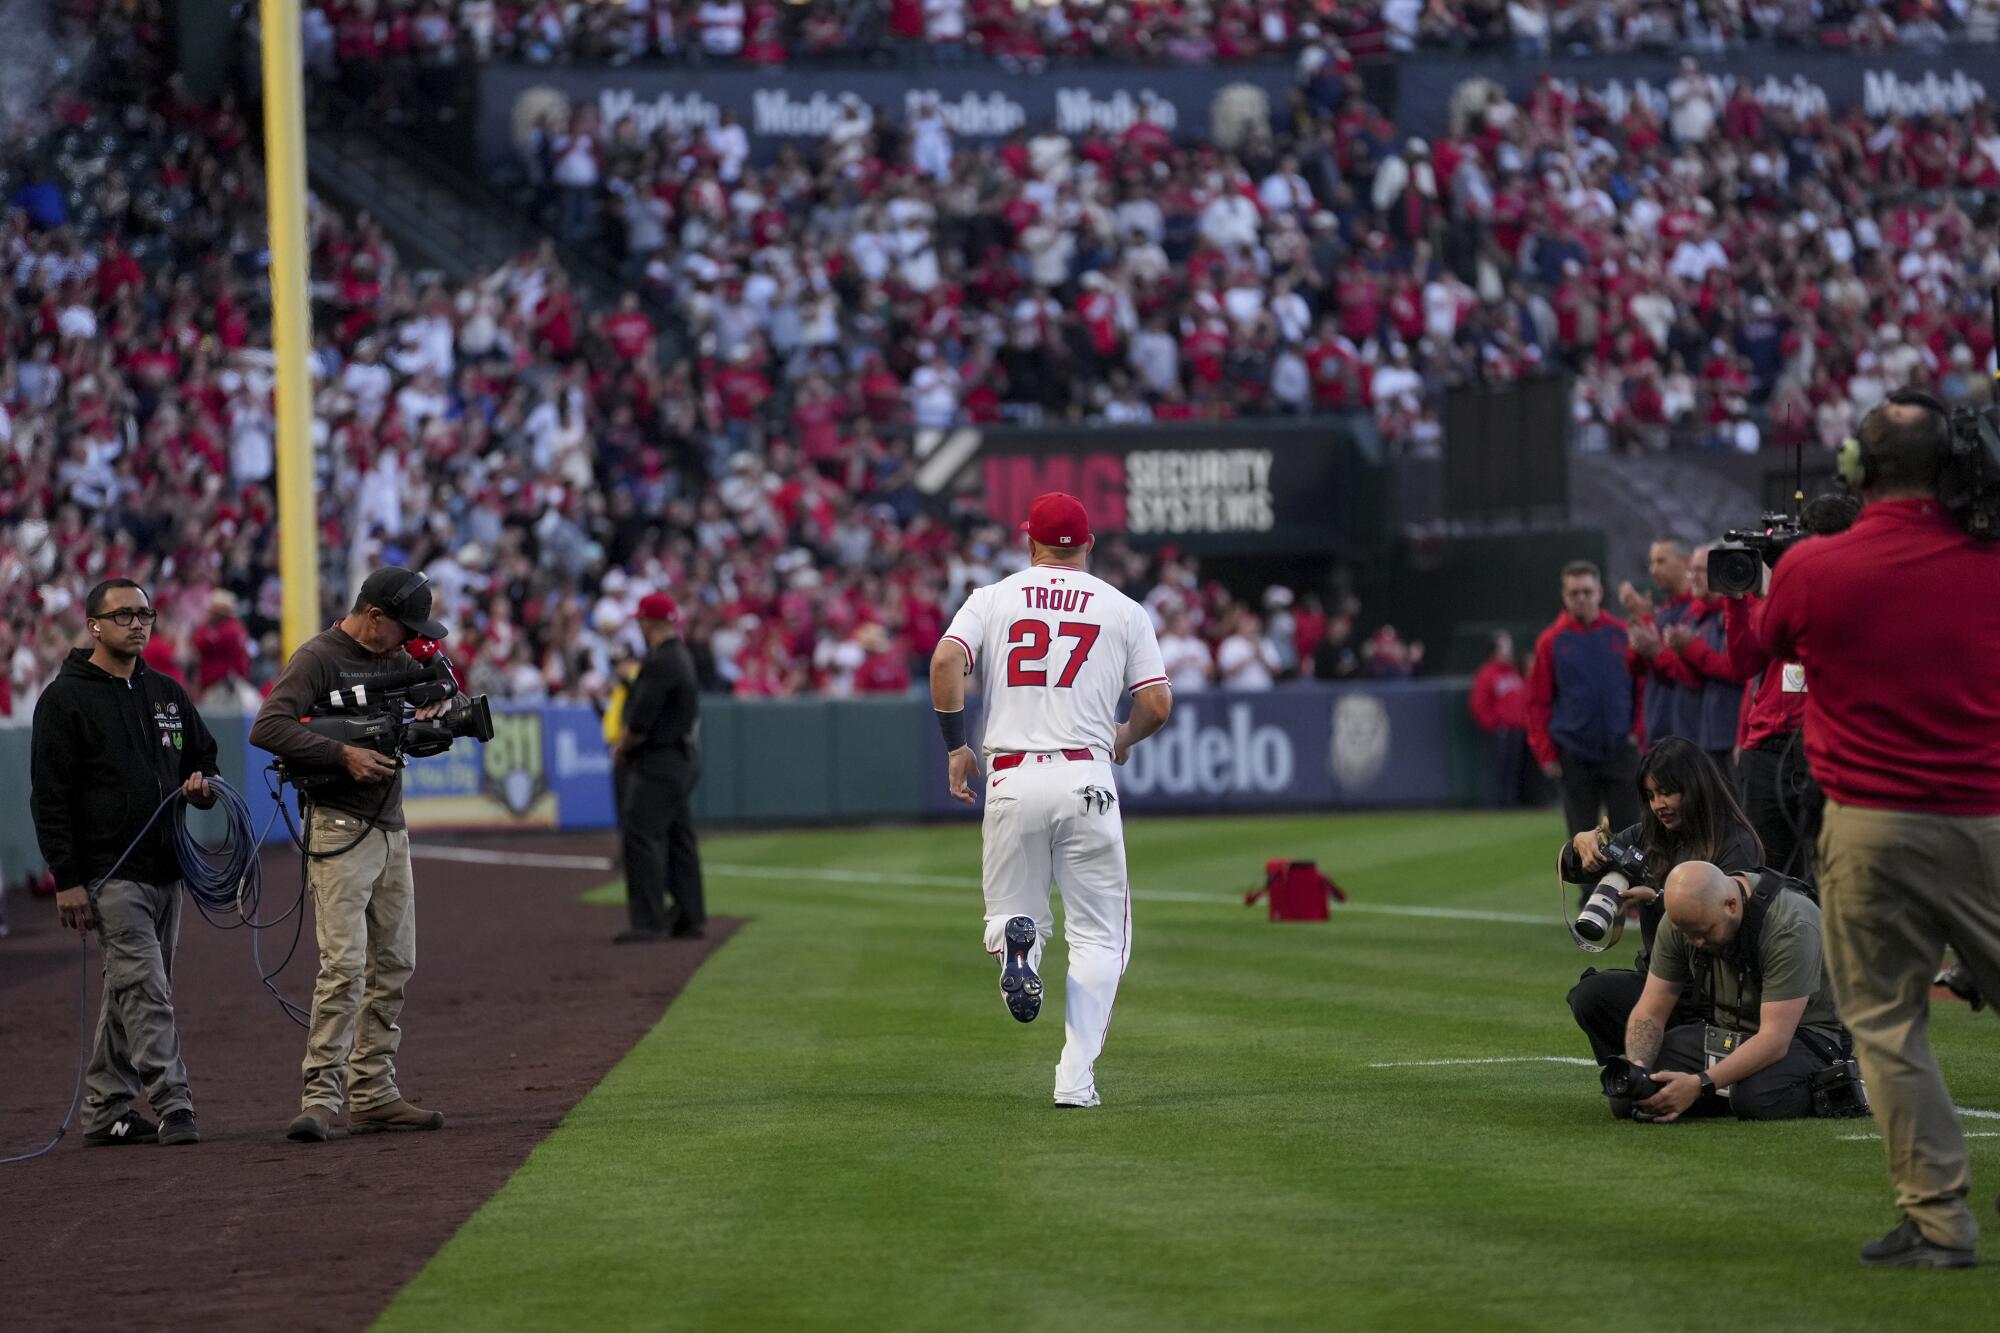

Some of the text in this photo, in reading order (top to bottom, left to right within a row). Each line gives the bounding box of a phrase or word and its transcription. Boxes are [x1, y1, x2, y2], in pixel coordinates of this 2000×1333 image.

[1126, 450, 1272, 489] SECURITY
[1127, 492, 1274, 532] SYSTEMS
[1021, 586, 1095, 614] TROUT
[1007, 618, 1101, 689] 27
[1118, 703, 1293, 796] odelo
